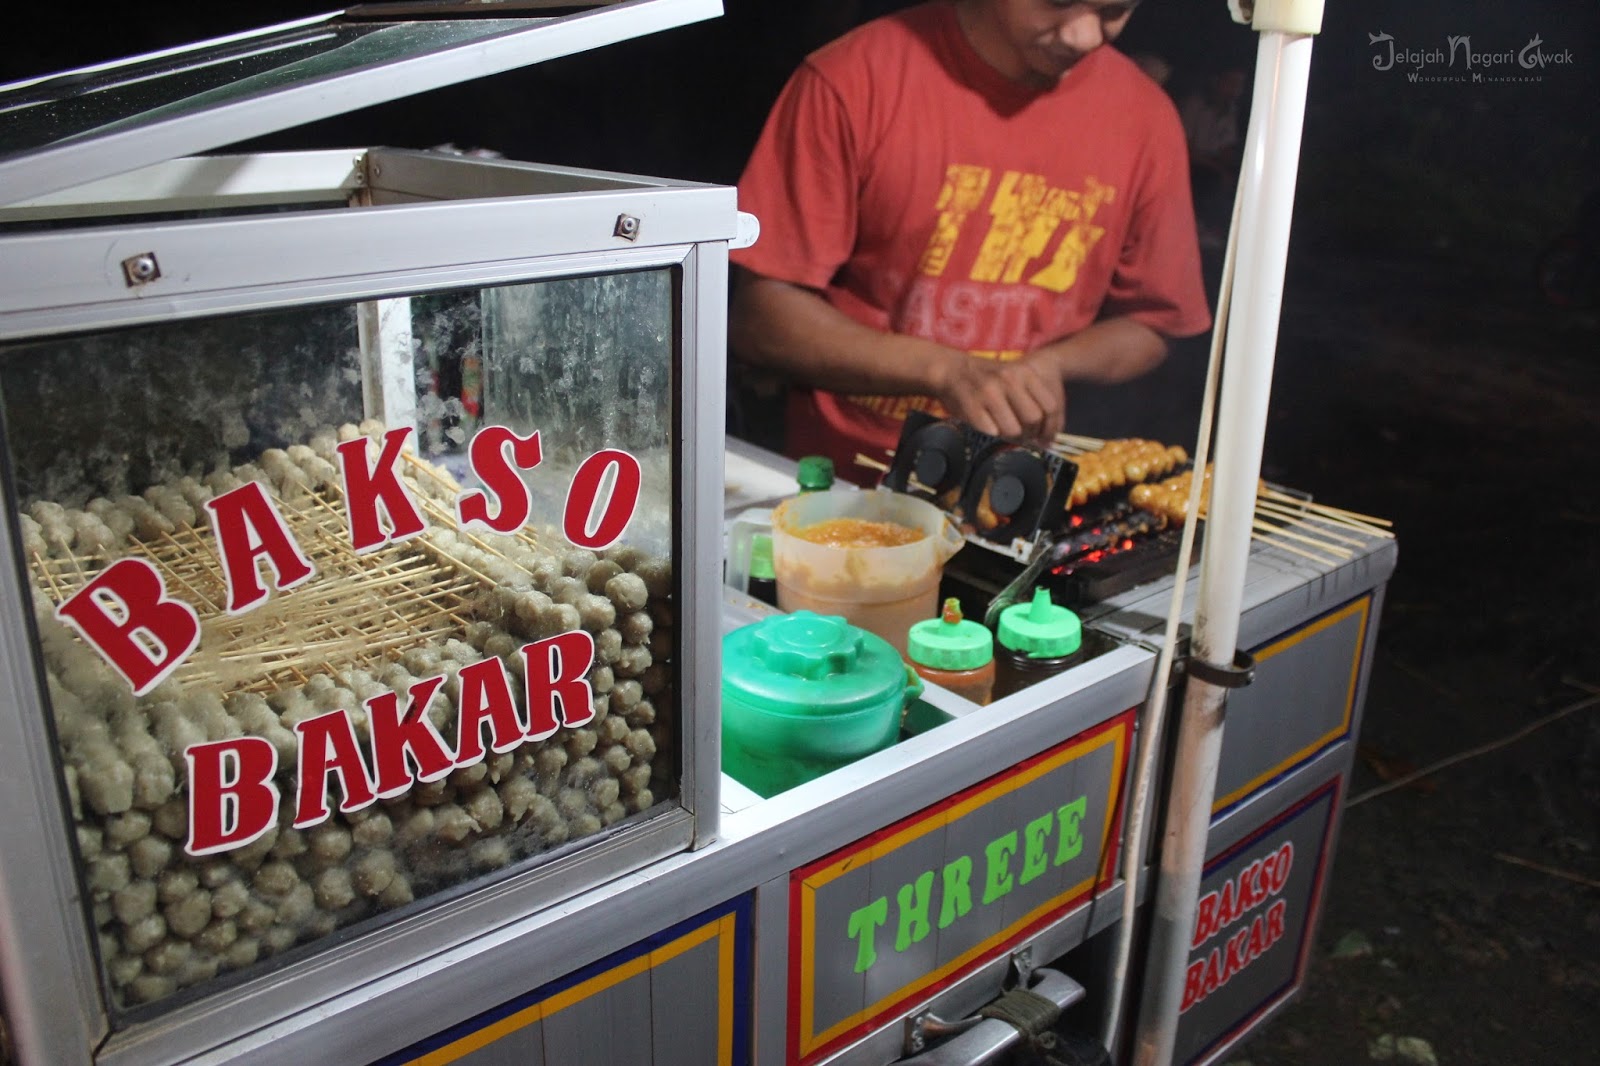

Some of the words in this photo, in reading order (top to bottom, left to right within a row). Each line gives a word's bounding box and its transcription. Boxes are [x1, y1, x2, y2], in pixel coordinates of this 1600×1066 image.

[55, 425, 642, 697] BAKSO
[183, 628, 597, 856] BAKAR
[848, 796, 1088, 974] THREEE
[1178, 898, 1287, 1016] BAKAR
[1191, 840, 1294, 950] BAKSO
